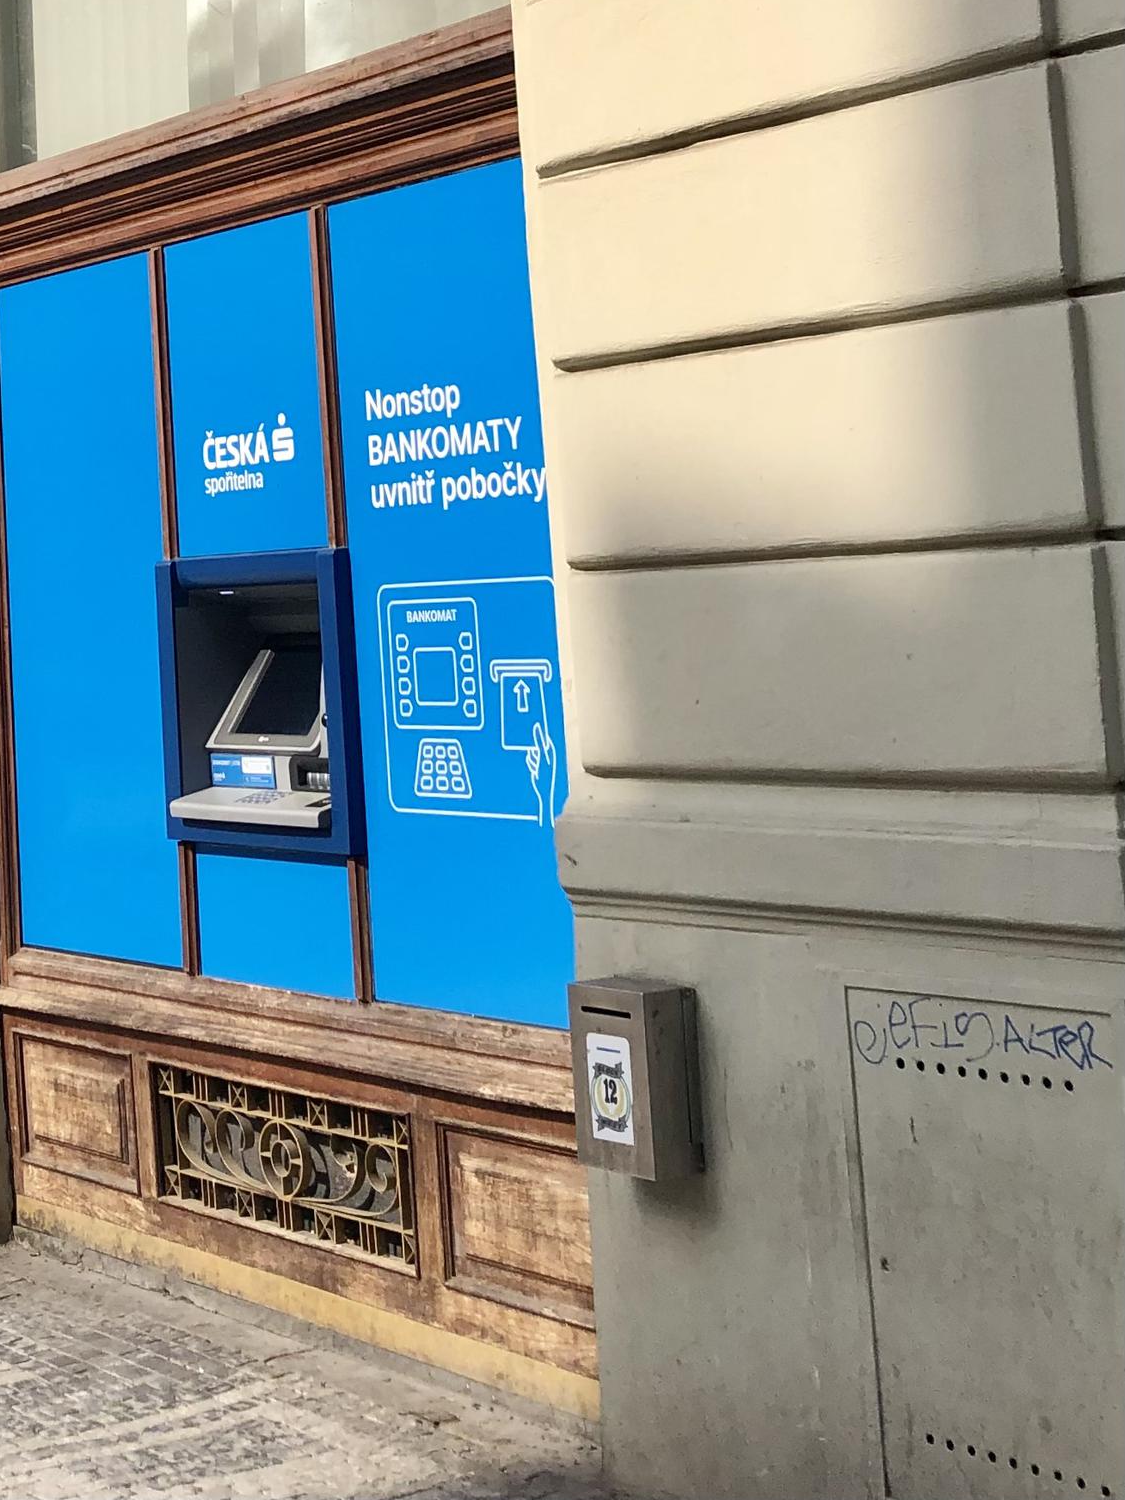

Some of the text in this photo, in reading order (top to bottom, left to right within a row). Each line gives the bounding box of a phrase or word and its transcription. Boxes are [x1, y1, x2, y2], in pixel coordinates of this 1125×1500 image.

[364, 383, 461, 421] Nonstop
[202, 422, 270, 470] ČESKÁ
[367, 415, 523, 467] BANKOMATY
[204, 470, 264, 497] spořitelna
[370, 461, 547, 511] uvnitř pobočky
[406, 608, 457, 623] BANKOMAT
[603, 1077, 618, 1105] 12
